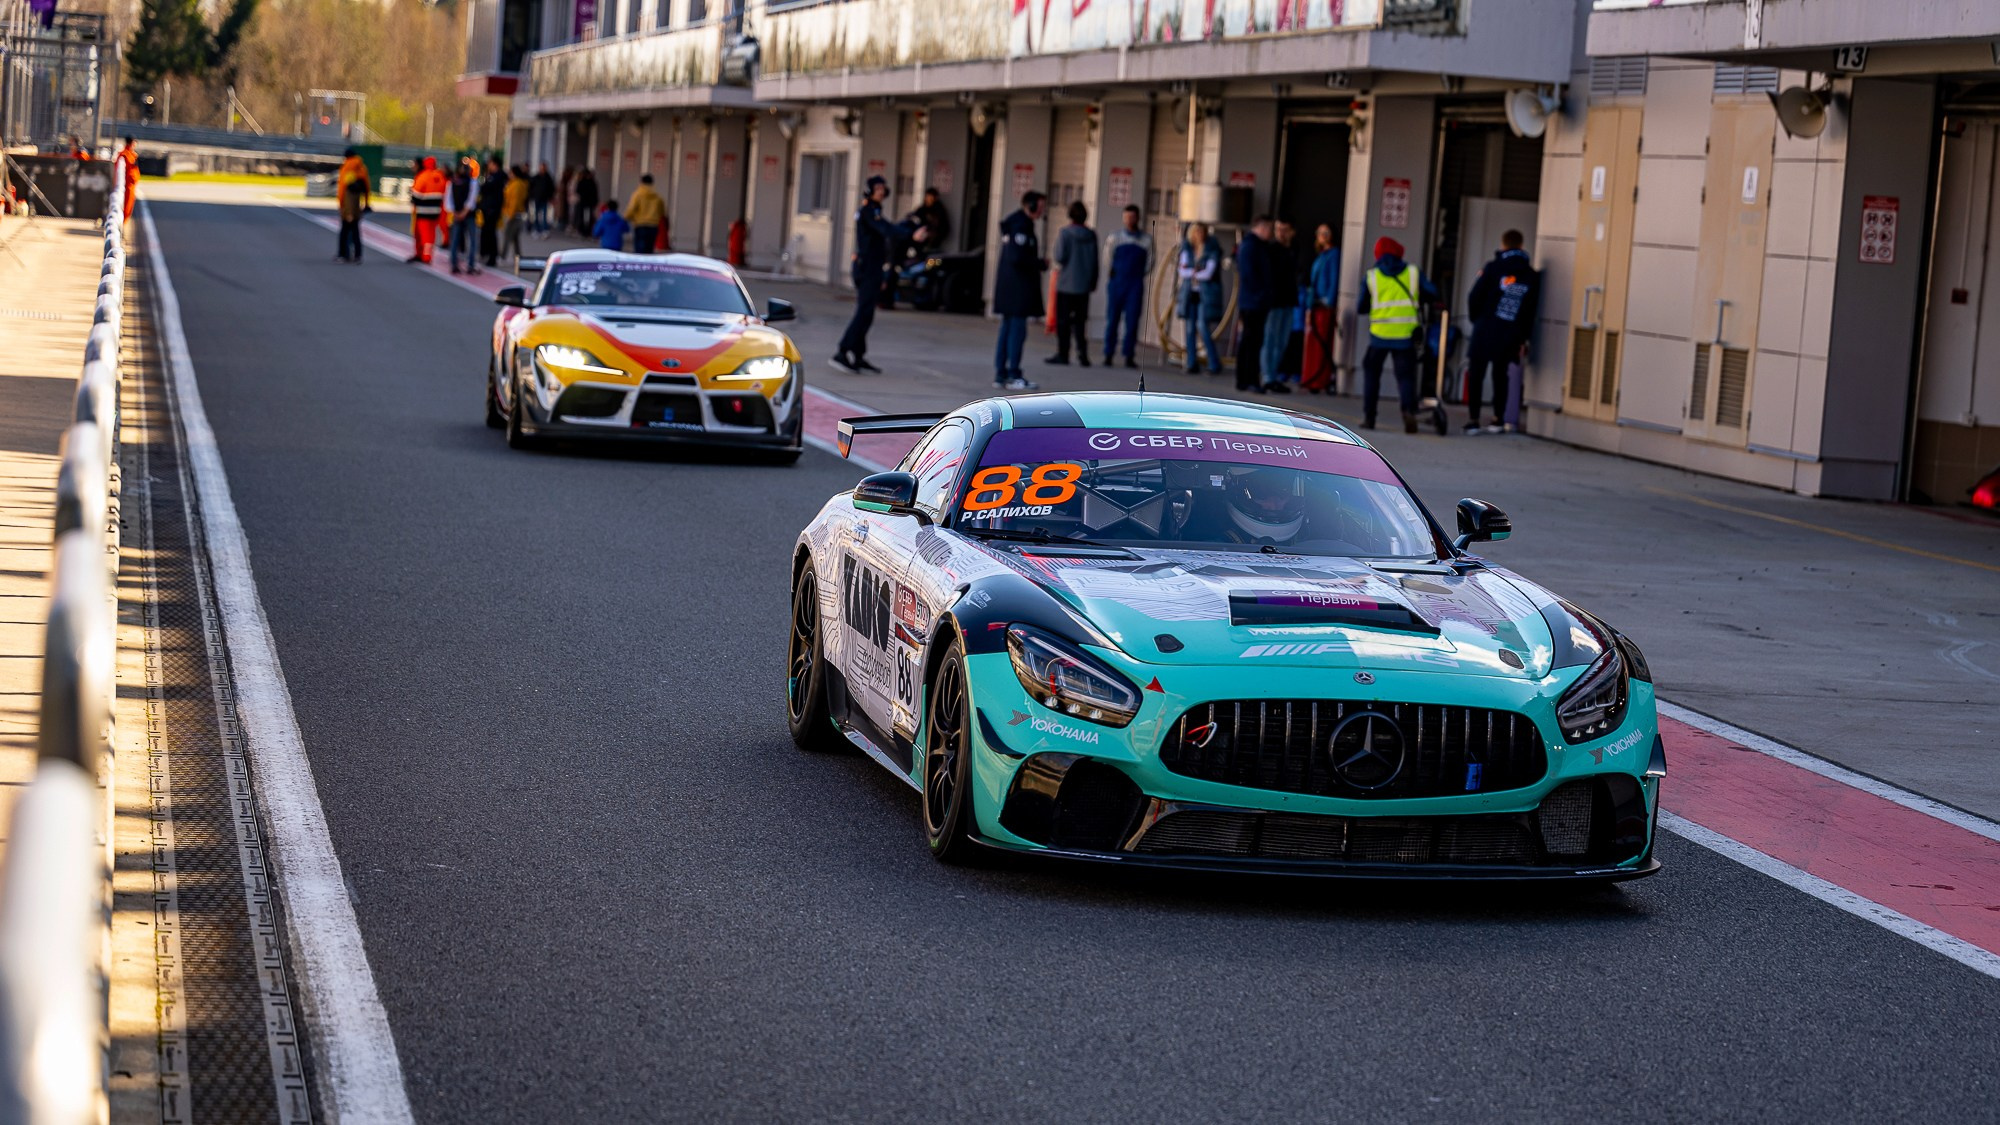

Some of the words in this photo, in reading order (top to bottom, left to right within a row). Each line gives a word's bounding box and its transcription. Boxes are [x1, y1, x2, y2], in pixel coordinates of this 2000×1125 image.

[1840, 47, 1863, 67] 13
[559, 279, 597, 296] 55
[1128, 435, 1203, 449] СБЕР
[1211, 437, 1309, 460] Первый
[962, 463, 1083, 511] 88
[960, 505, 1053, 522] Р.САЛИХОВ
[898, 646, 912, 706] 88
[1030, 717, 1099, 745] YOKOHAMA
[1603, 728, 1644, 757] YOKOHAMA
